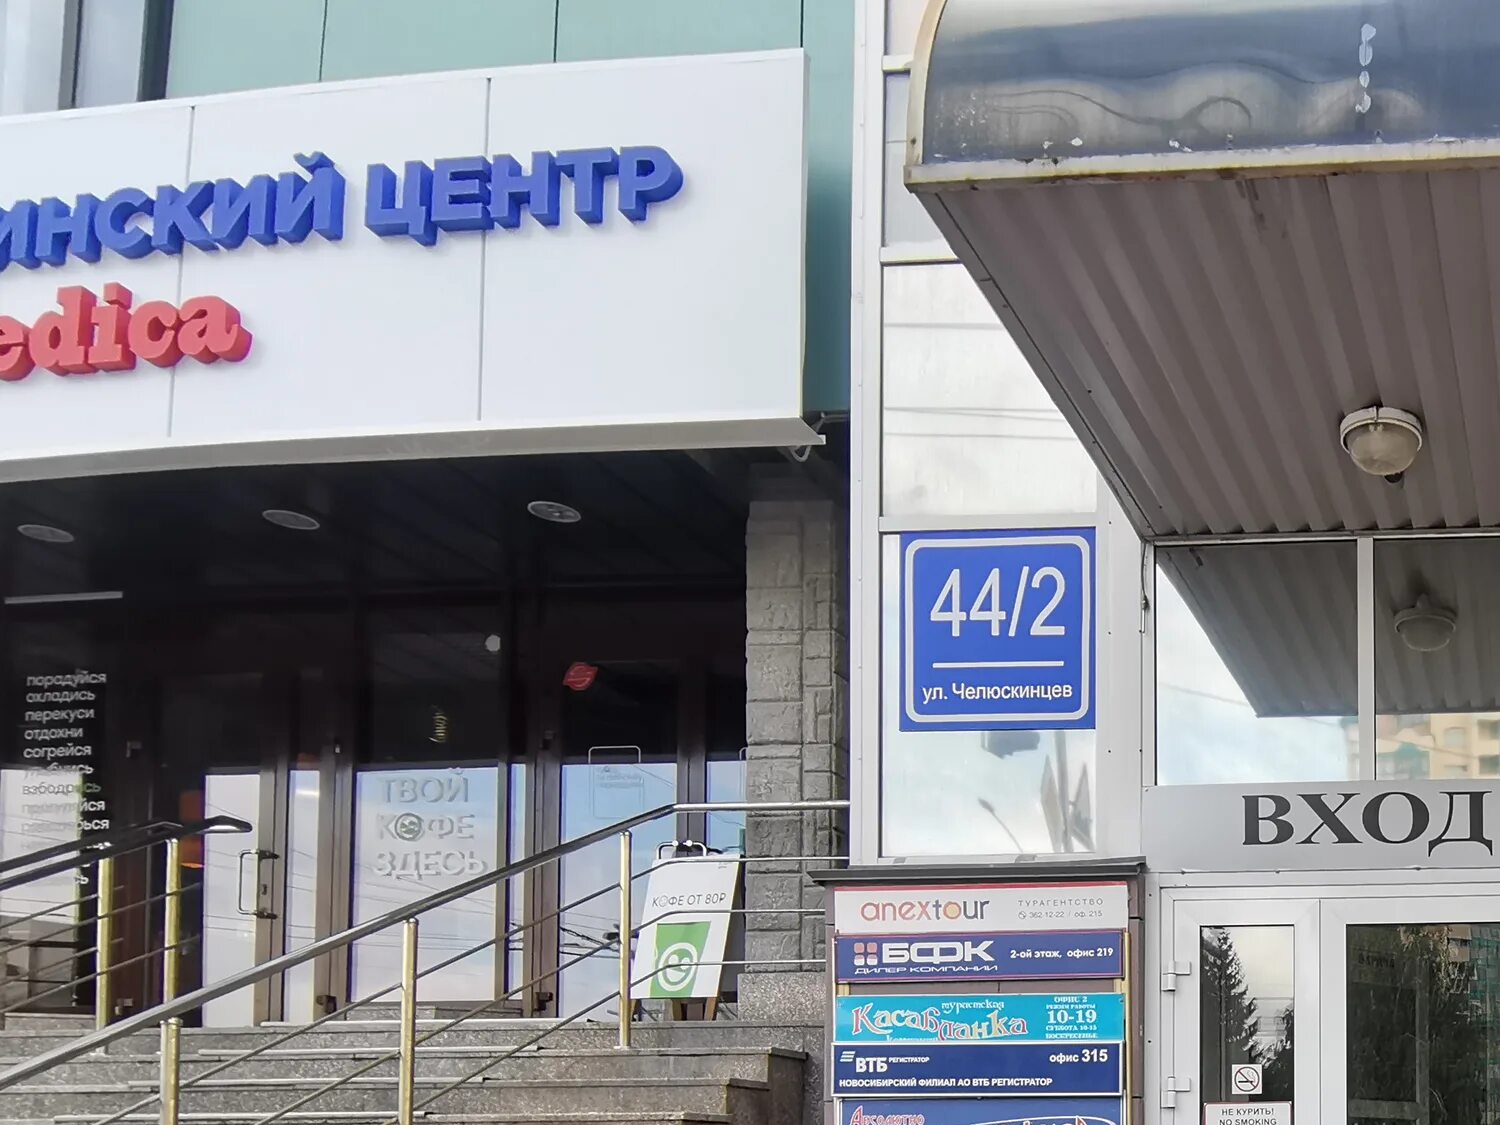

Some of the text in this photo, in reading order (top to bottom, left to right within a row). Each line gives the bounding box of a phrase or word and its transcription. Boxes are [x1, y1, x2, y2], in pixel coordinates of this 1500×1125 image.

[364, 145, 684, 247] ЦЕНТР
[0, 282, 253, 381] edica
[930, 566, 1066, 637] 44/2
[922, 682, 1073, 704] ул. Челюскинцев
[25, 709, 95, 724] перекуси
[24, 728, 84, 741] отдохни
[23, 743, 92, 760] согрейся
[386, 770, 469, 803] ТВОЙ
[1242, 790, 1494, 858] ВХОД
[376, 851, 489, 881] ЗДЕСЬ
[687, 894, 702, 905] ОТ
[1018, 897, 1104, 907] ТУРАГЕНТСТВО
[860, 900, 990, 922] anextour
[882, 941, 1114, 964] БФК 2-ой этаж, офис 219
[854, 964, 998, 975] ДИЛЕР КОМПАНИИ
[852, 1001, 1030, 1041] Касабланка
[1047, 1009, 1097, 1024] 10-19
[1049, 1049, 1109, 1063] офис 315
[856, 1057, 888, 1073] ВТБ
[839, 1076, 1053, 1087] НОВОСИБИРСКИЙ ФИЛИАЛ АО ВТБ РЕГИСТРАТОР
[1221, 1107, 1275, 1116] НЕ КУРИТЬ!
[1235, 1118, 1277, 1125] SMOKING
